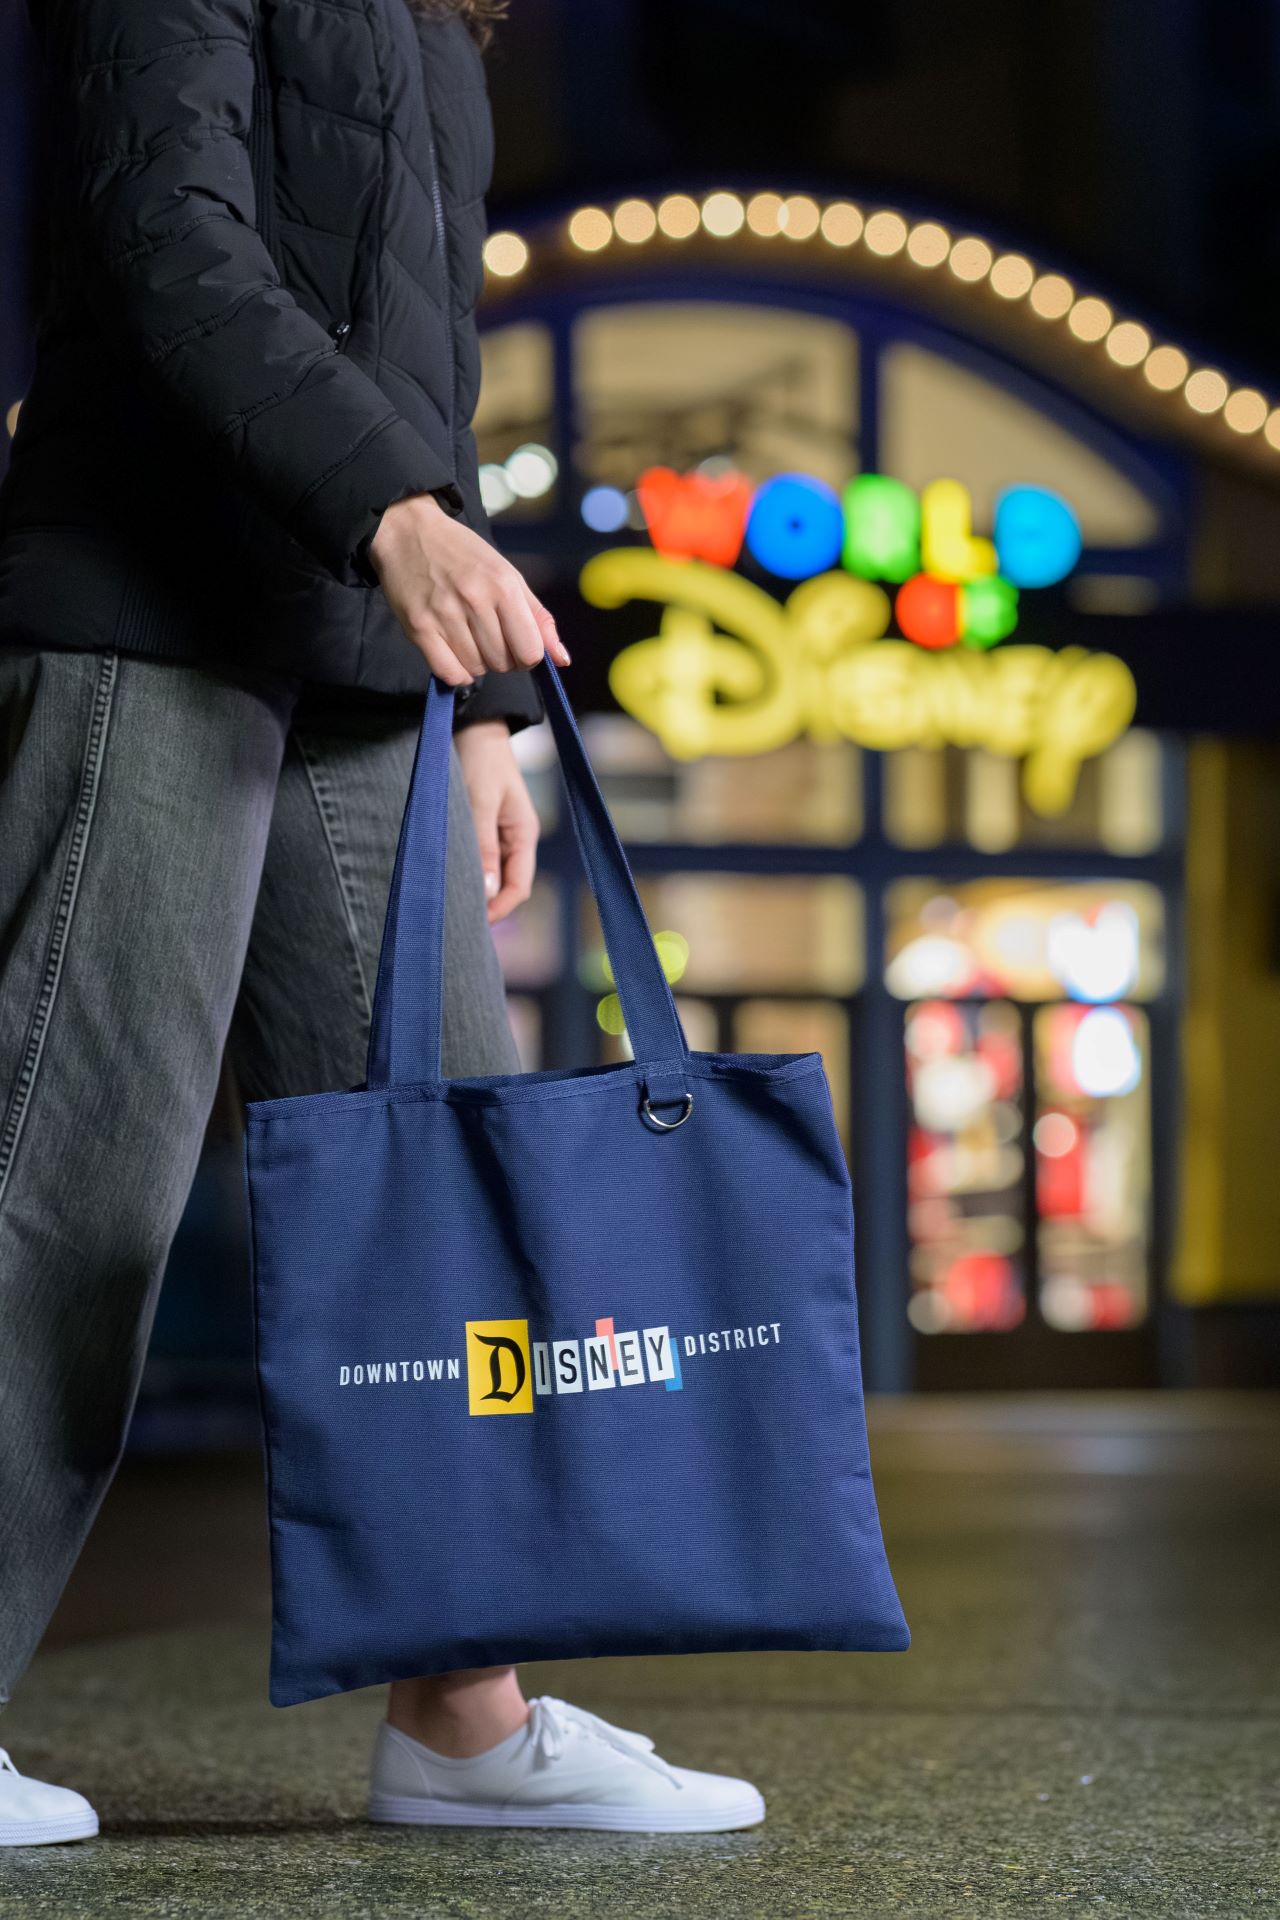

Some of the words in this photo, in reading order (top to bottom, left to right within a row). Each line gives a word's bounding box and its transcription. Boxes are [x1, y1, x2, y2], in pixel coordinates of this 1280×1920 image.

[580, 547, 1137, 816] Diy
[339, 1358, 460, 1386] DOWNTOWN
[473, 1332, 665, 1403] DISNEY
[684, 1323, 781, 1356] DISTRICT
